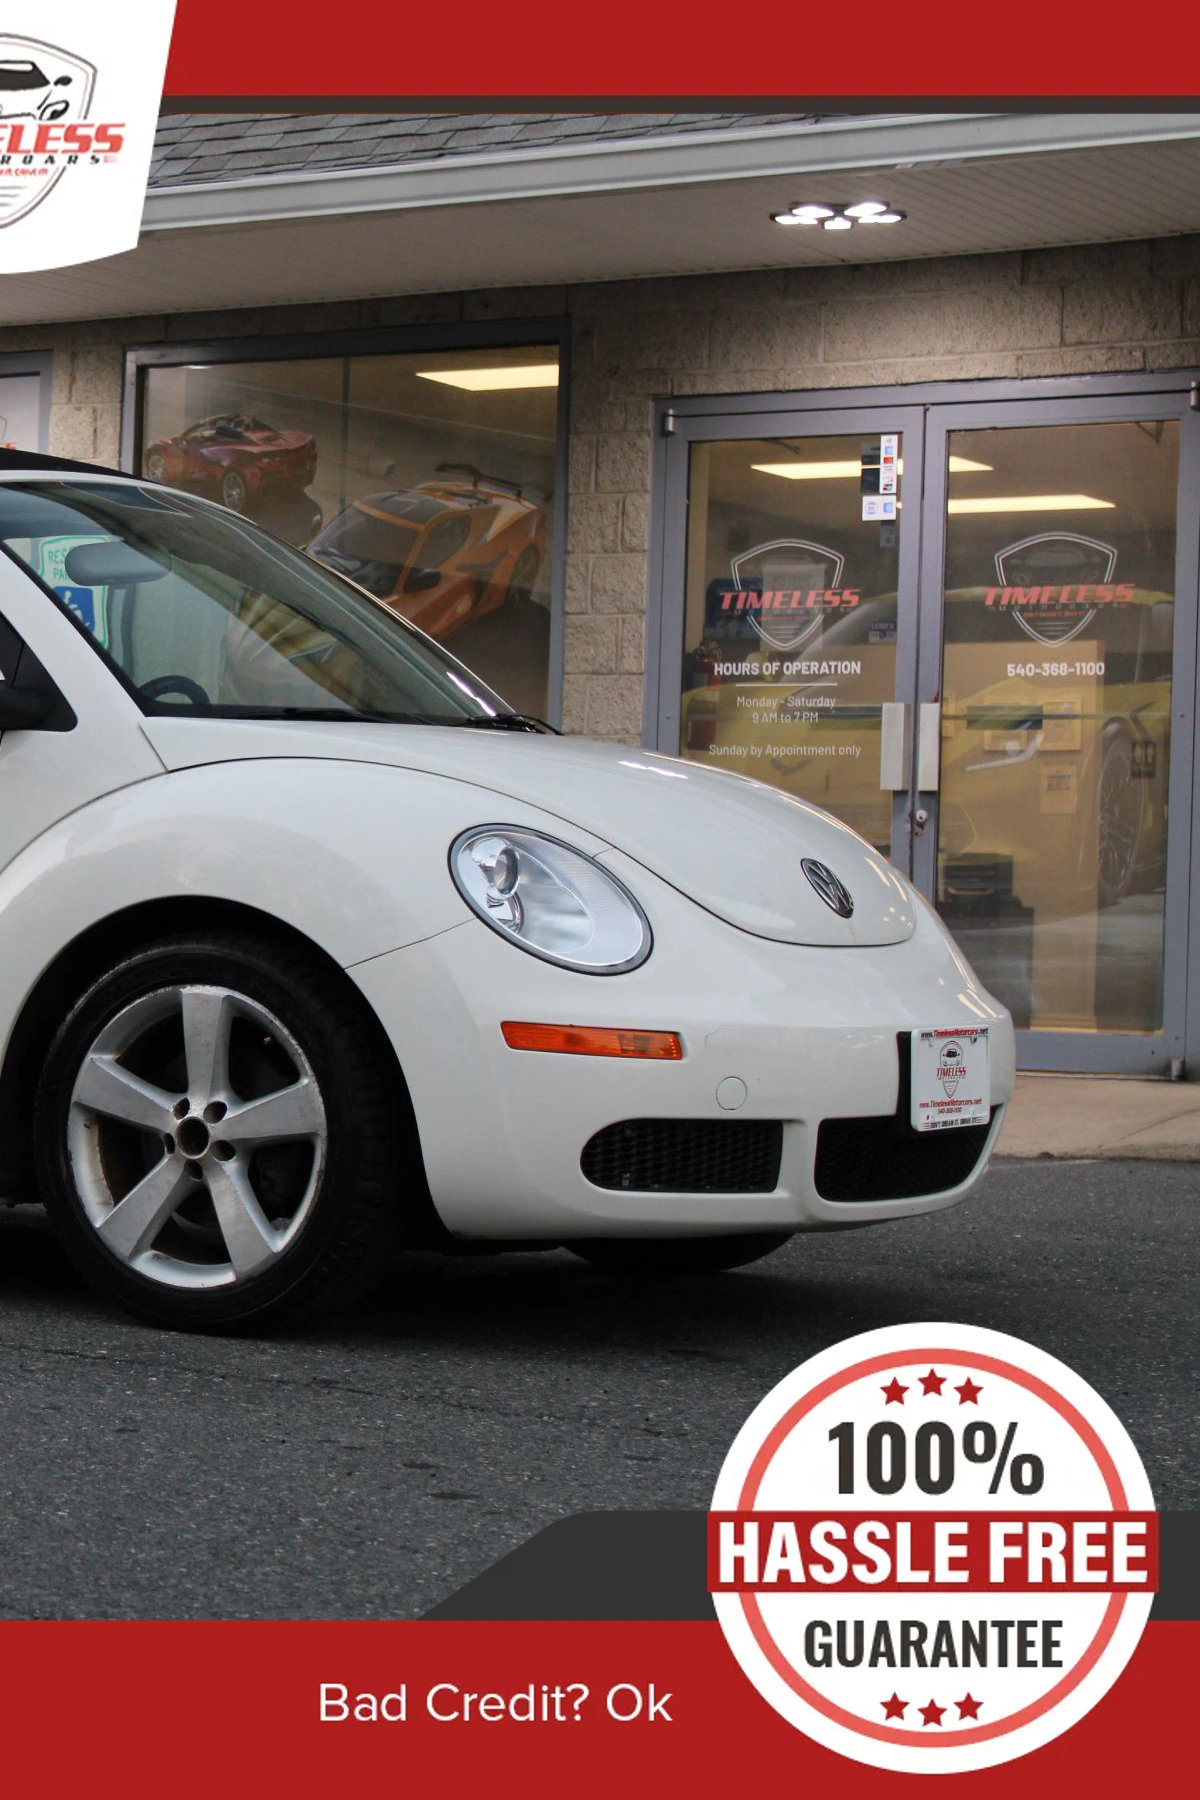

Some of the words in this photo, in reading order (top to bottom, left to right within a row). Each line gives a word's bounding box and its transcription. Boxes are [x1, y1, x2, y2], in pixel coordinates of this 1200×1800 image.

[720, 588, 863, 609] TIMELESS
[983, 583, 1136, 606] TIMELESS
[714, 662, 759, 676] HOURS
[763, 661, 781, 675] OF
[783, 660, 861, 675] OPERATION
[1007, 662, 1105, 677] 540-368-1100
[736, 696, 778, 709] Monday
[787, 695, 836, 710] Saturday
[752, 712, 759, 724] 9
[762, 712, 778, 723] AM
[780, 712, 790, 723] to
[794, 711, 801, 722] 7
[802, 711, 819, 723] PM
[709, 744, 748, 758] Sunday
[750, 744, 762, 758] by
[765, 743, 836, 759] Appointment
[838, 742, 861, 758] only
[937, 1067, 967, 1077] TIMELESS
